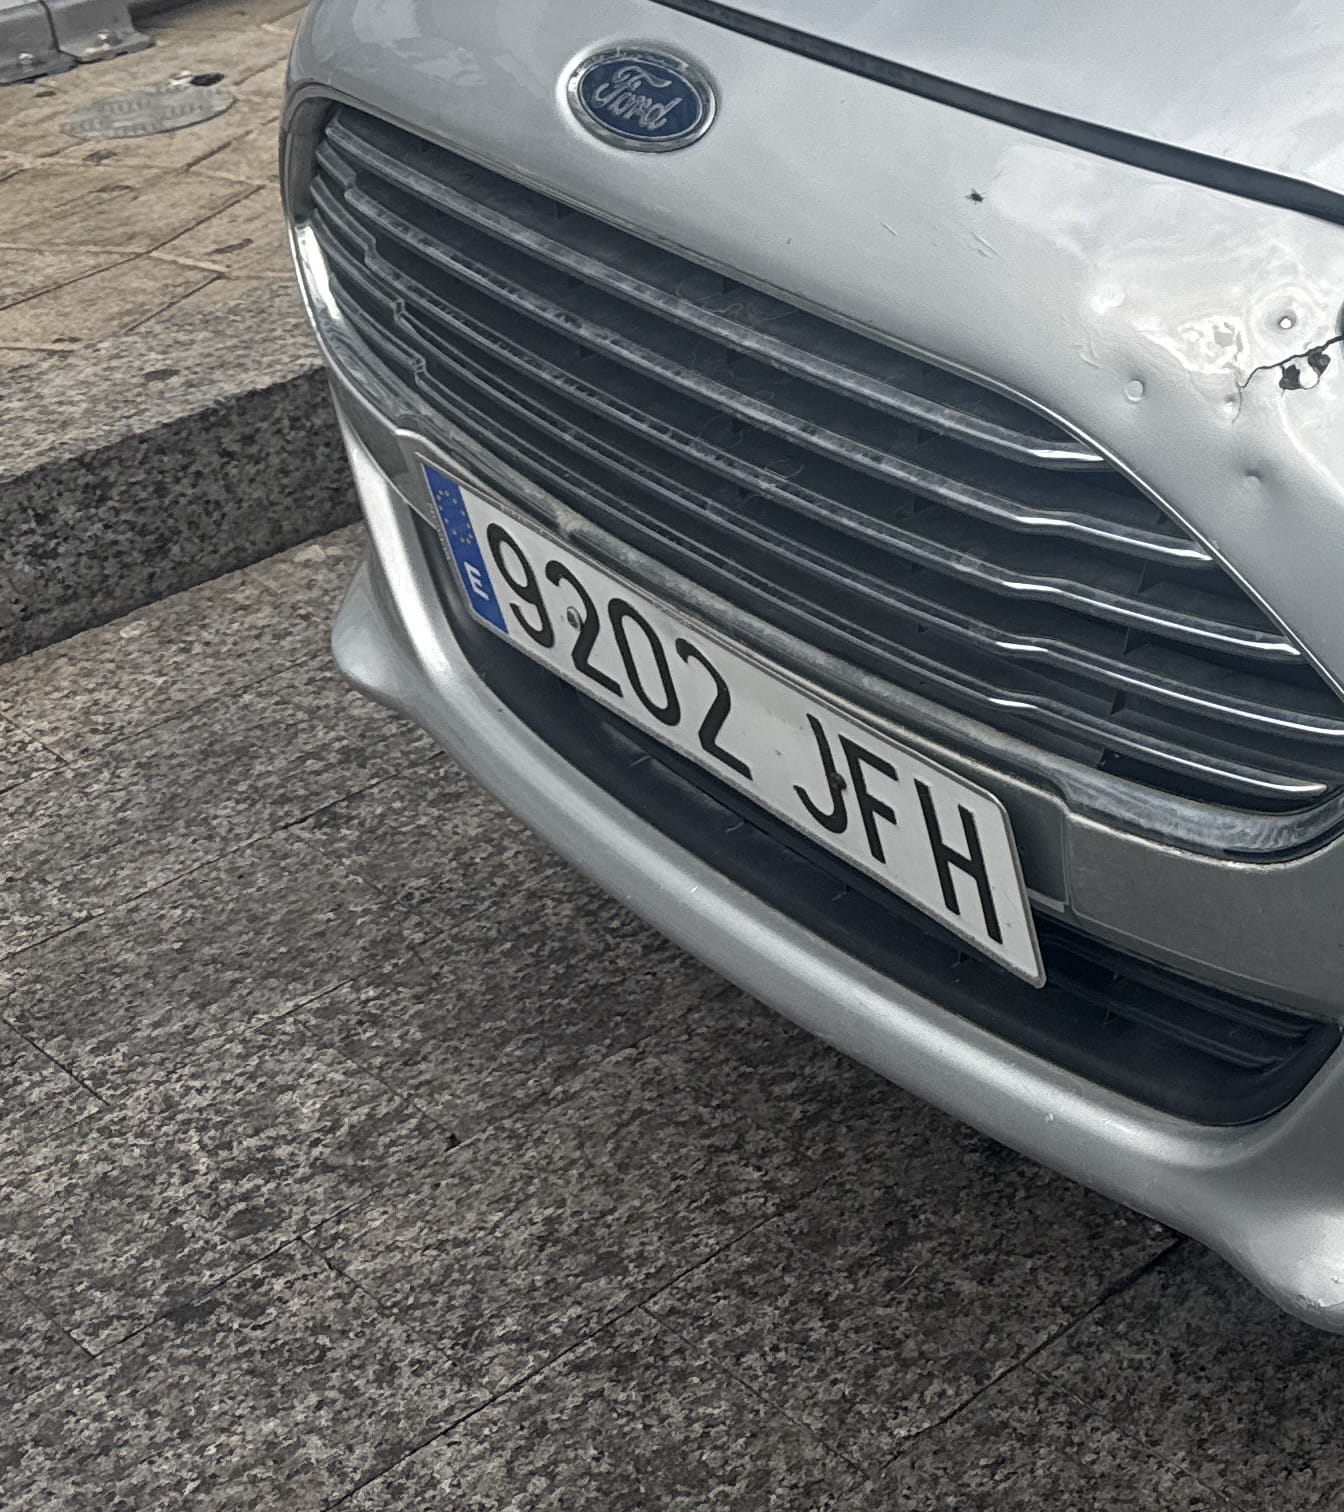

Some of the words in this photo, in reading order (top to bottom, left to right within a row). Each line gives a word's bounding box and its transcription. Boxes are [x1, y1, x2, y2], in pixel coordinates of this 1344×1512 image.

[590, 64, 683, 131] Ford
[463, 561, 490, 601] E
[485, 521, 754, 782] 9202
[792, 712, 1004, 946] JFH
